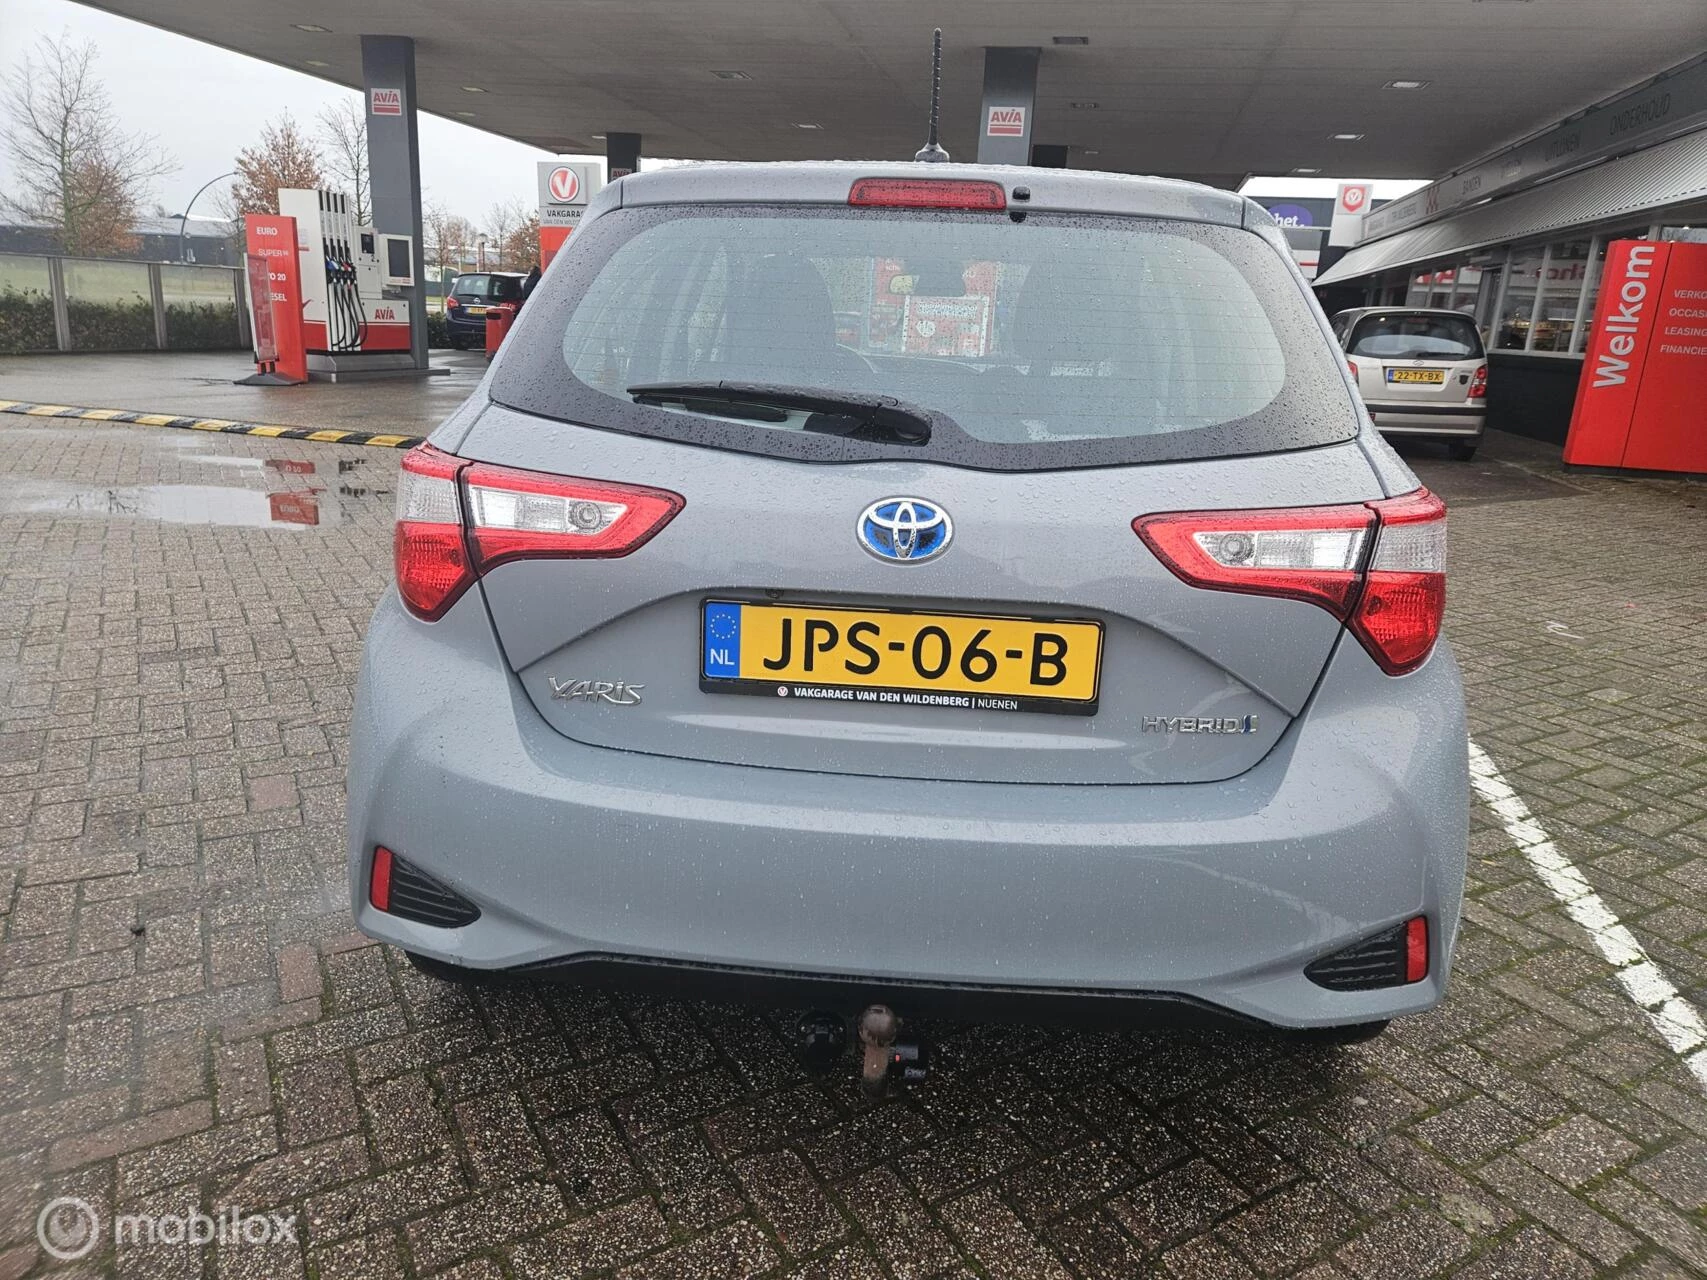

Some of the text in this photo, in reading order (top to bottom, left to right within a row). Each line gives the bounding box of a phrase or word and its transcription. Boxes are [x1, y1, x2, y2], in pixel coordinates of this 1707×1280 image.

[374, 91, 400, 103] AVIA
[991, 109, 1023, 123] AVIA
[256, 227, 278, 236] EURO
[374, 306, 396, 321] AVIA
[1592, 246, 1656, 388] Welkom
[710, 649, 735, 665] NL
[763, 618, 1068, 686] JPS-06-B
[794, 687, 1018, 710] VAKGARAGE VAN DEN WILDENBERG NUENEN
